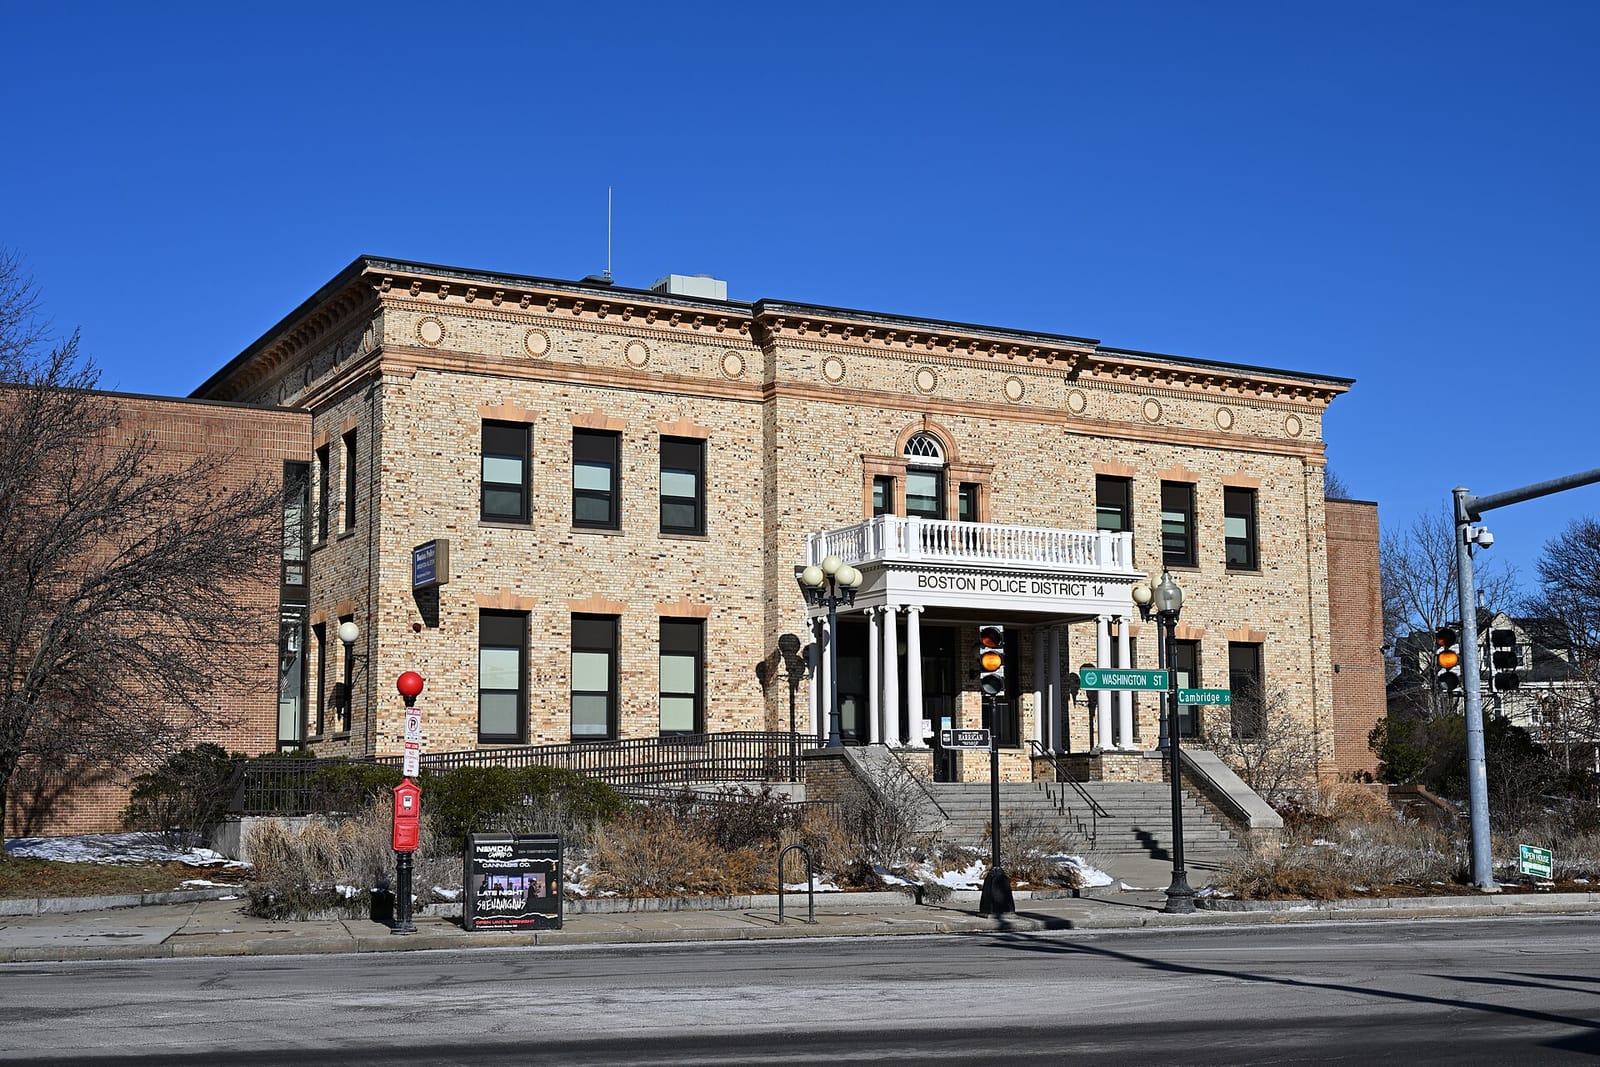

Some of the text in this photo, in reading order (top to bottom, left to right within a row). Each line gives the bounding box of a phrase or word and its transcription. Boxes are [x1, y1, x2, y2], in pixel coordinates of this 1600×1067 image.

[918, 575, 1104, 597] BOSTON POLICE DISTRICT 14
[1101, 673, 1163, 686] WASHINGTON ST
[1179, 690, 1221, 705] Cambridge
[476, 898, 527, 911] SHENANIGANS
